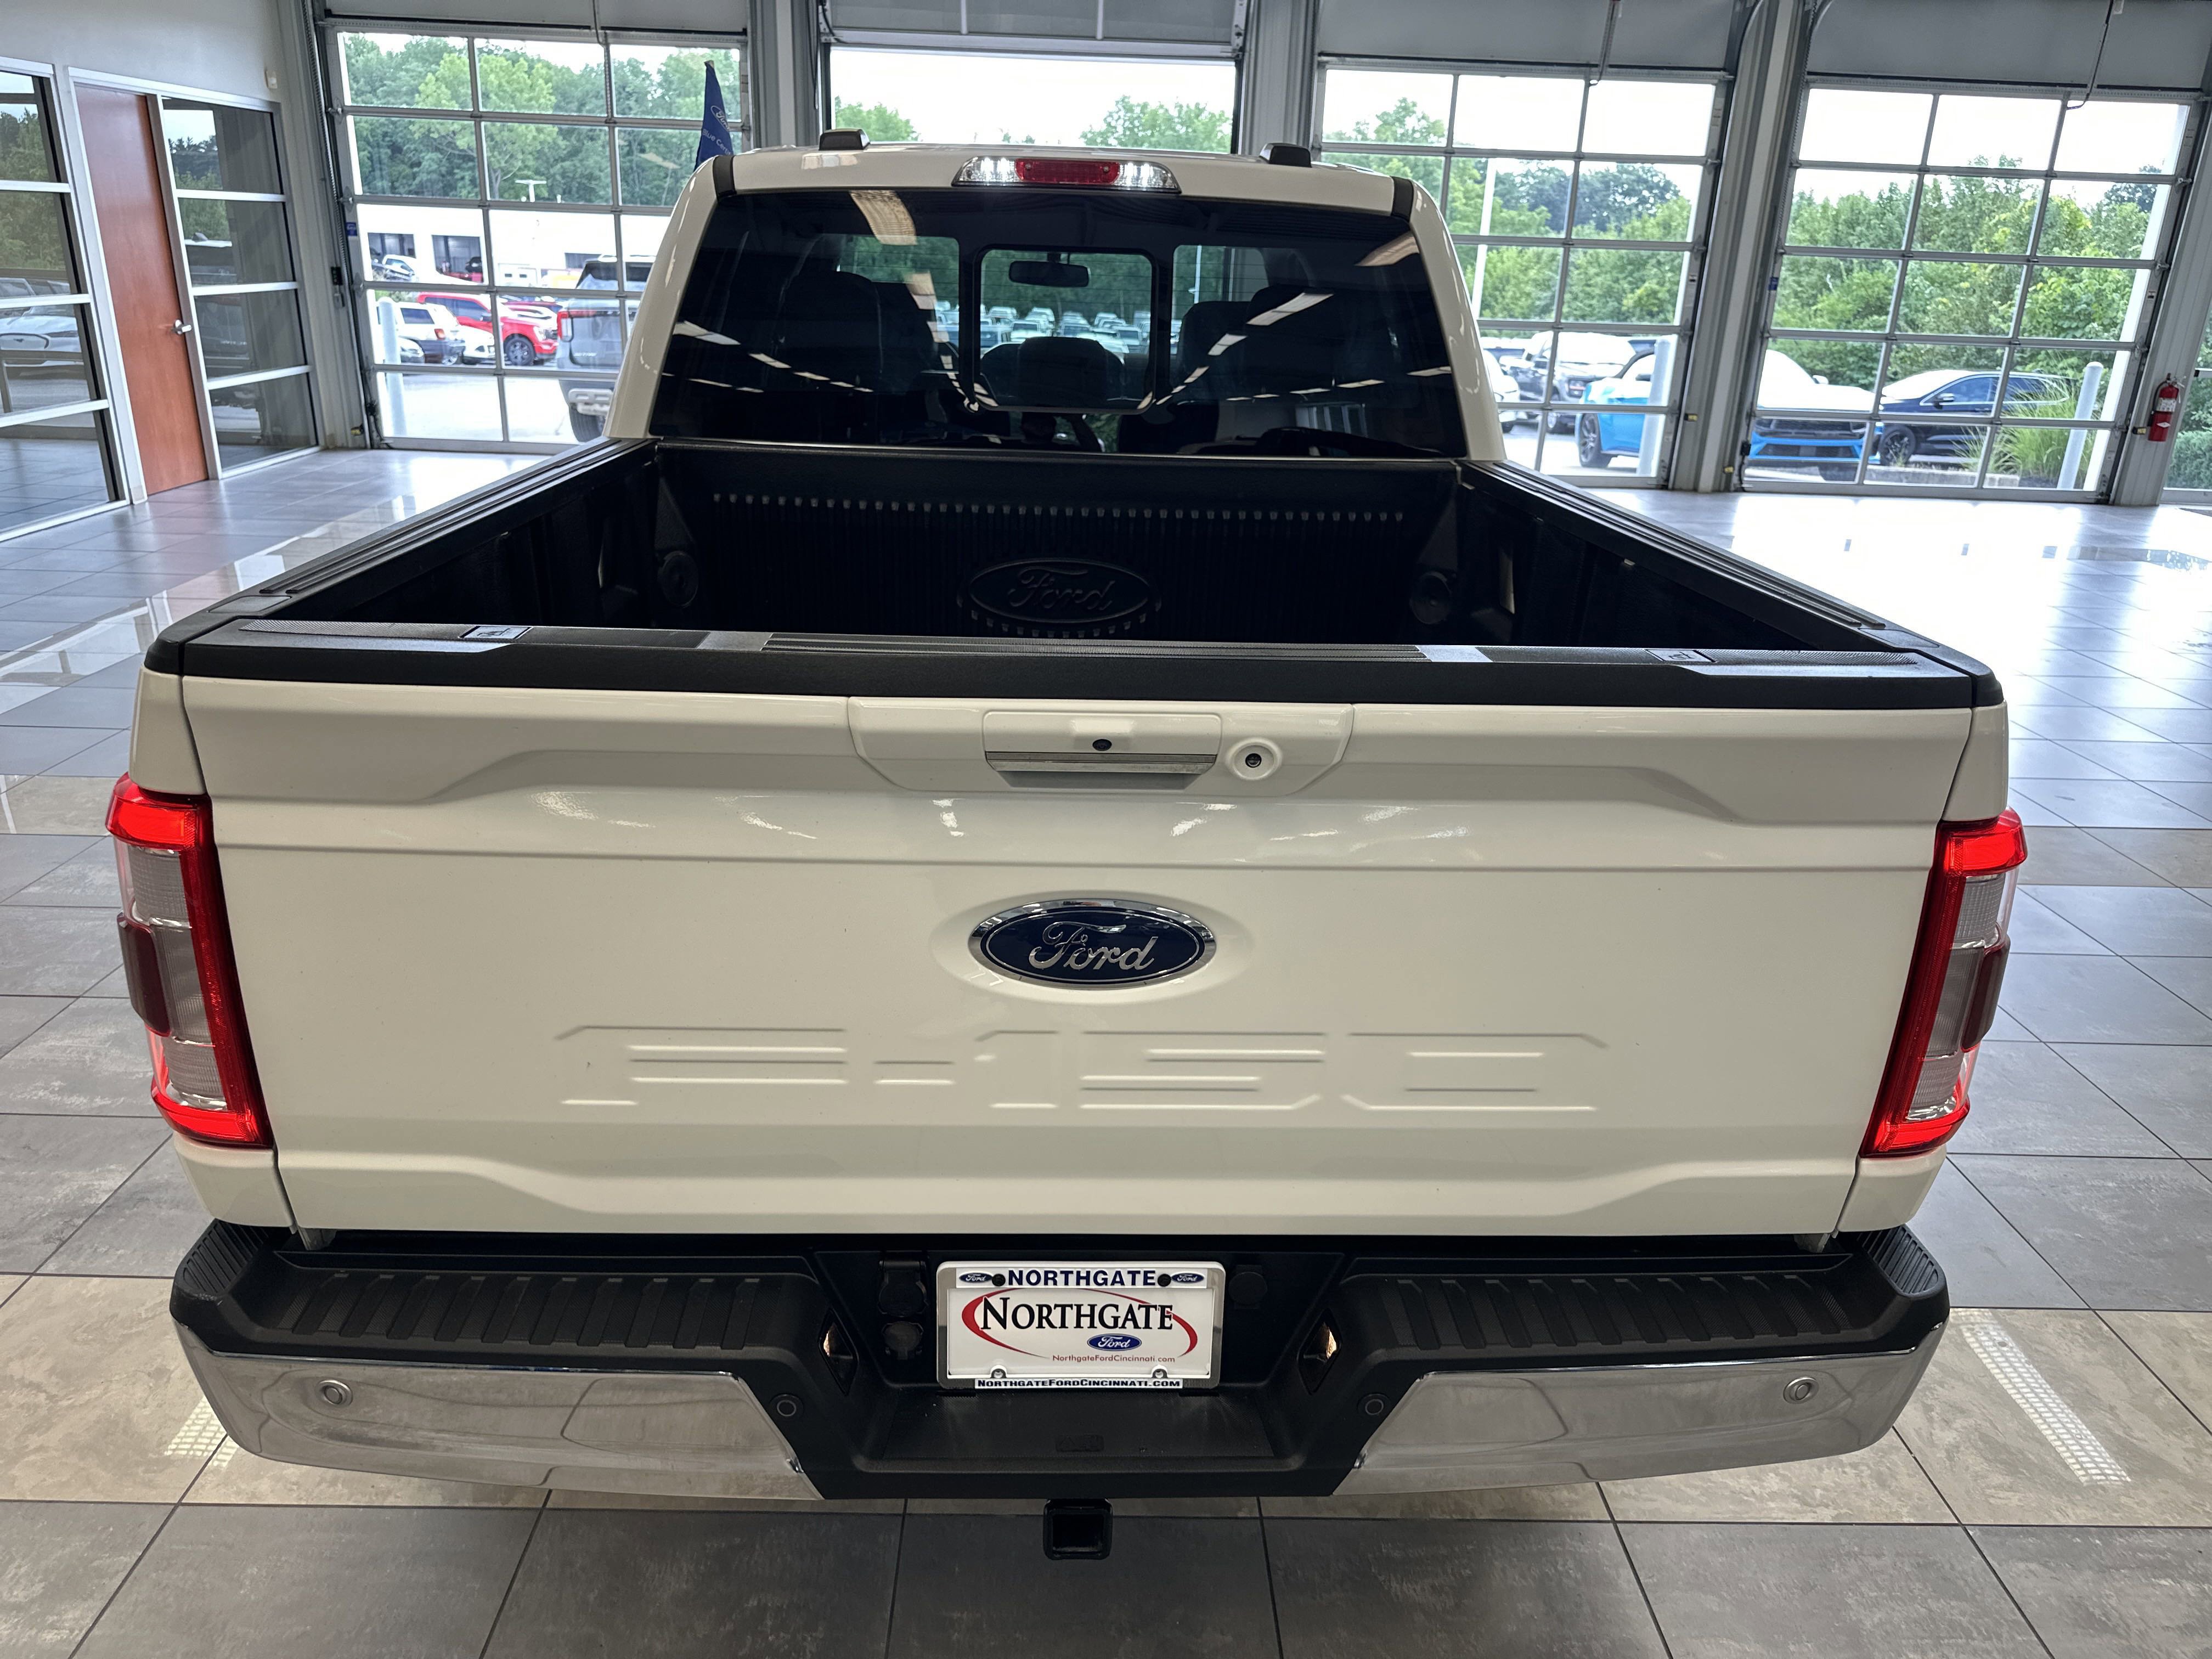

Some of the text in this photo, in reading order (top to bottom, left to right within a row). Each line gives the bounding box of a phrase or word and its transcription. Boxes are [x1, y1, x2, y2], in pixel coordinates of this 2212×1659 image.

[702, 129, 715, 141] Blue
[1007, 566, 1115, 611] Ford
[1029, 921, 1158, 970] Ford
[1008, 1269, 1156, 1286] NORTHGATE
[1097, 1336, 1130, 1348] Ford
[1053, 1355, 1175, 1363] NorthgateFordCincinnati.com
